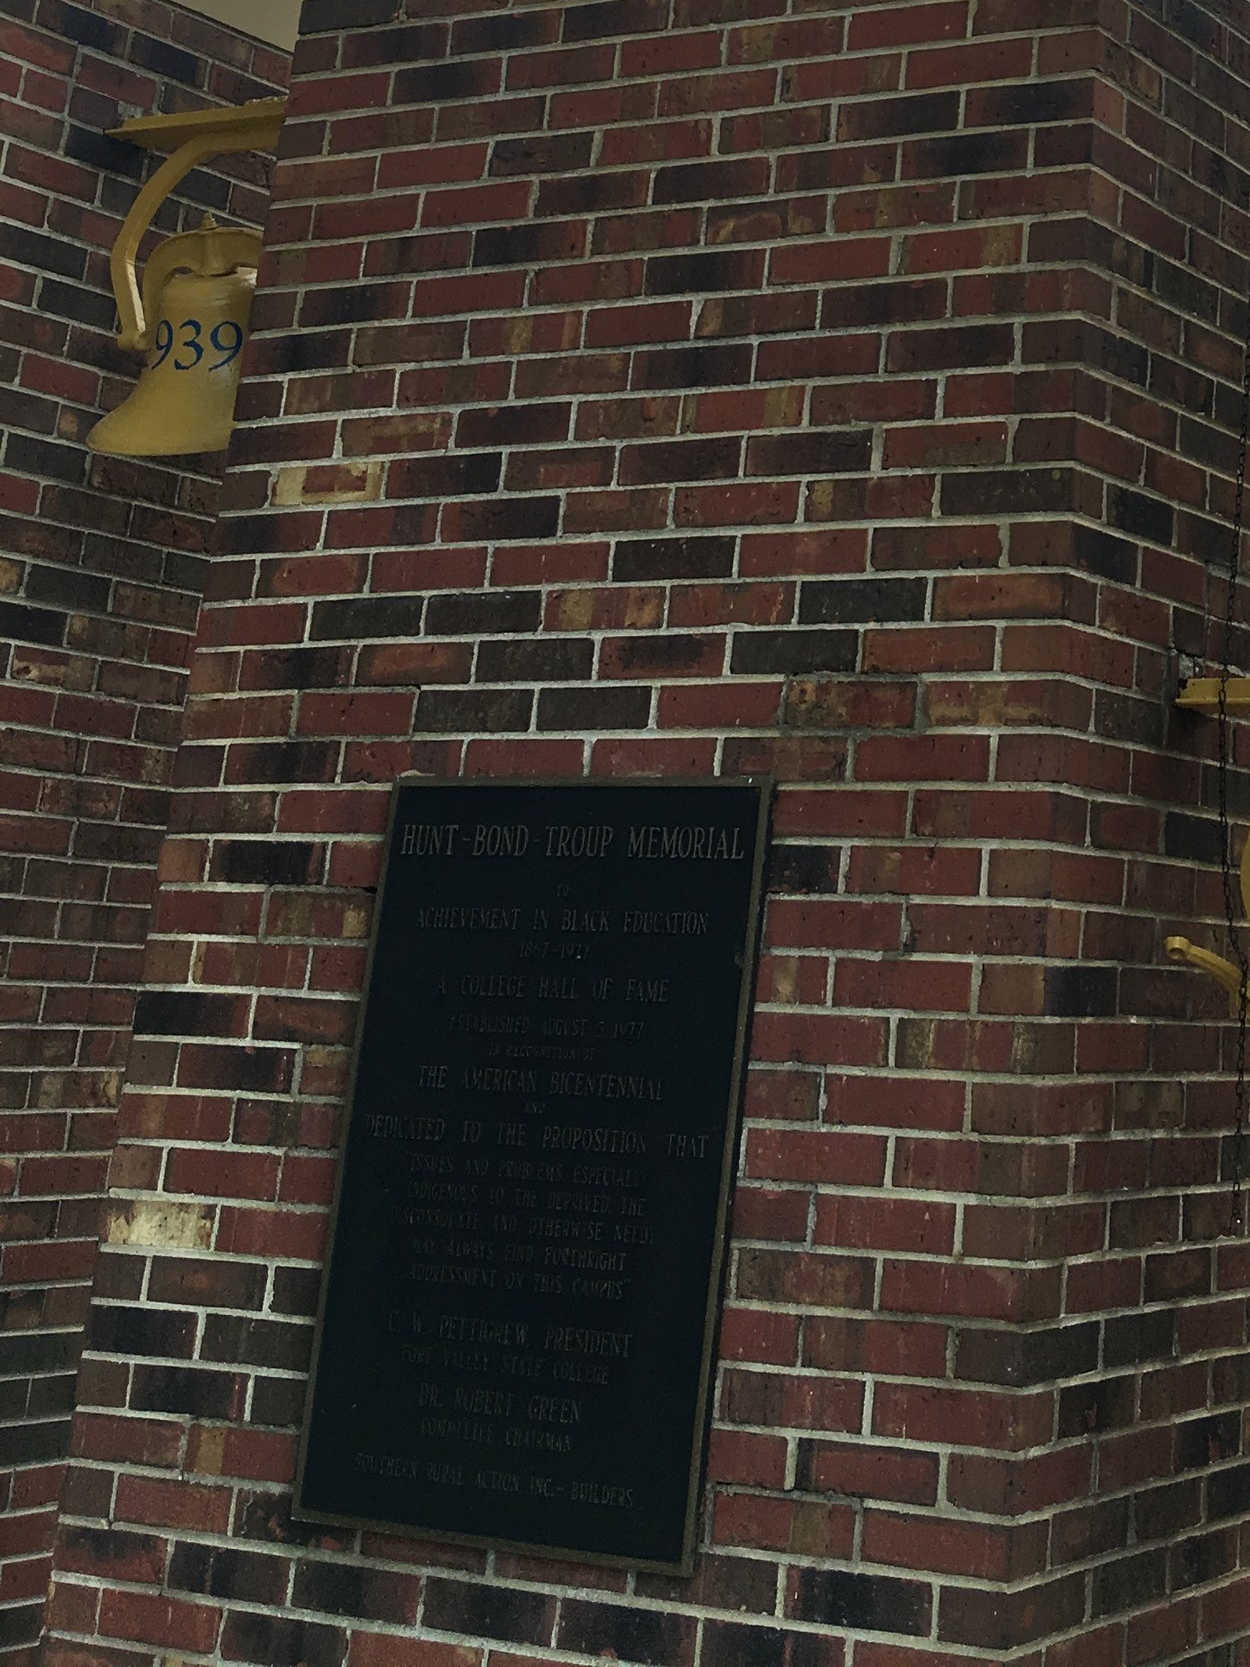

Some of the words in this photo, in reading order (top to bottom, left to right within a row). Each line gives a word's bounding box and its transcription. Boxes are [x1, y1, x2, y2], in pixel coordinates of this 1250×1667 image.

[151, 319, 243, 372] 939
[627, 826, 744, 860] MEMORIAL
[415, 907, 522, 931] ACHIEVEMENT
[532, 909, 549, 931] IN
[561, 909, 610, 933] BLACK
[623, 911, 709, 934] EDUCATION
[436, 975, 447, 995] A
[460, 974, 526, 998] COLLEGE
[538, 977, 579, 1000] HALL
[592, 978, 613, 1001] OF
[625, 979, 670, 1003] FAME
[450, 1014, 531, 1035] ESTABLISHED
[542, 1018, 588, 1037] AUGUST
[612, 1021, 645, 1039] 1977
[417, 1065, 448, 1089] THE
[461, 1067, 538, 1093] AMERICAN
[549, 1071, 663, 1101] BICENTENNIAL
[365, 1113, 446, 1142] DEDICATED
[461, 1120, 482, 1143] TO
[496, 1122, 528, 1147] THE
[541, 1125, 648, 1154] PROPOSITION
[666, 1133, 710, 1159] THAT
[463, 1157, 490, 1176] AND
[498, 1159, 563, 1182] PROBLEMS
[572, 1163, 646, 1188] ESPECIALLY
[407, 1182, 479, 1203] INDIGENOUS
[489, 1187, 505, 1205] TO
[514, 1188, 538, 1208] THE
[620, 1195, 646, 1217] THE
[492, 1214, 518, 1233] AND
[528, 1217, 604, 1241] OTHERWISE
[447, 1238, 495, 1260] ALWAYS
[544, 1246, 627, 1271] FORTHRIGHT
[505, 1271, 523, 1289] ON
[534, 1272, 563, 1294] THIS
[544, 1326, 633, 1358] PRESIDENT
[401, 1344, 434, 1365] FORT
[444, 1348, 489, 1371] VALLEY
[501, 1355, 547, 1377] STATE
[553, 1360, 608, 1384] COLLEGE
[454, 1386, 515, 1416] ROBERT
[528, 1395, 583, 1423] GREEN
[505, 1427, 571, 1452] CHAIRMAN
[353, 1452, 419, 1478] SOUTHERN
[426, 1461, 465, 1485] RURAL
[570, 1481, 634, 1508] BUILDERS
